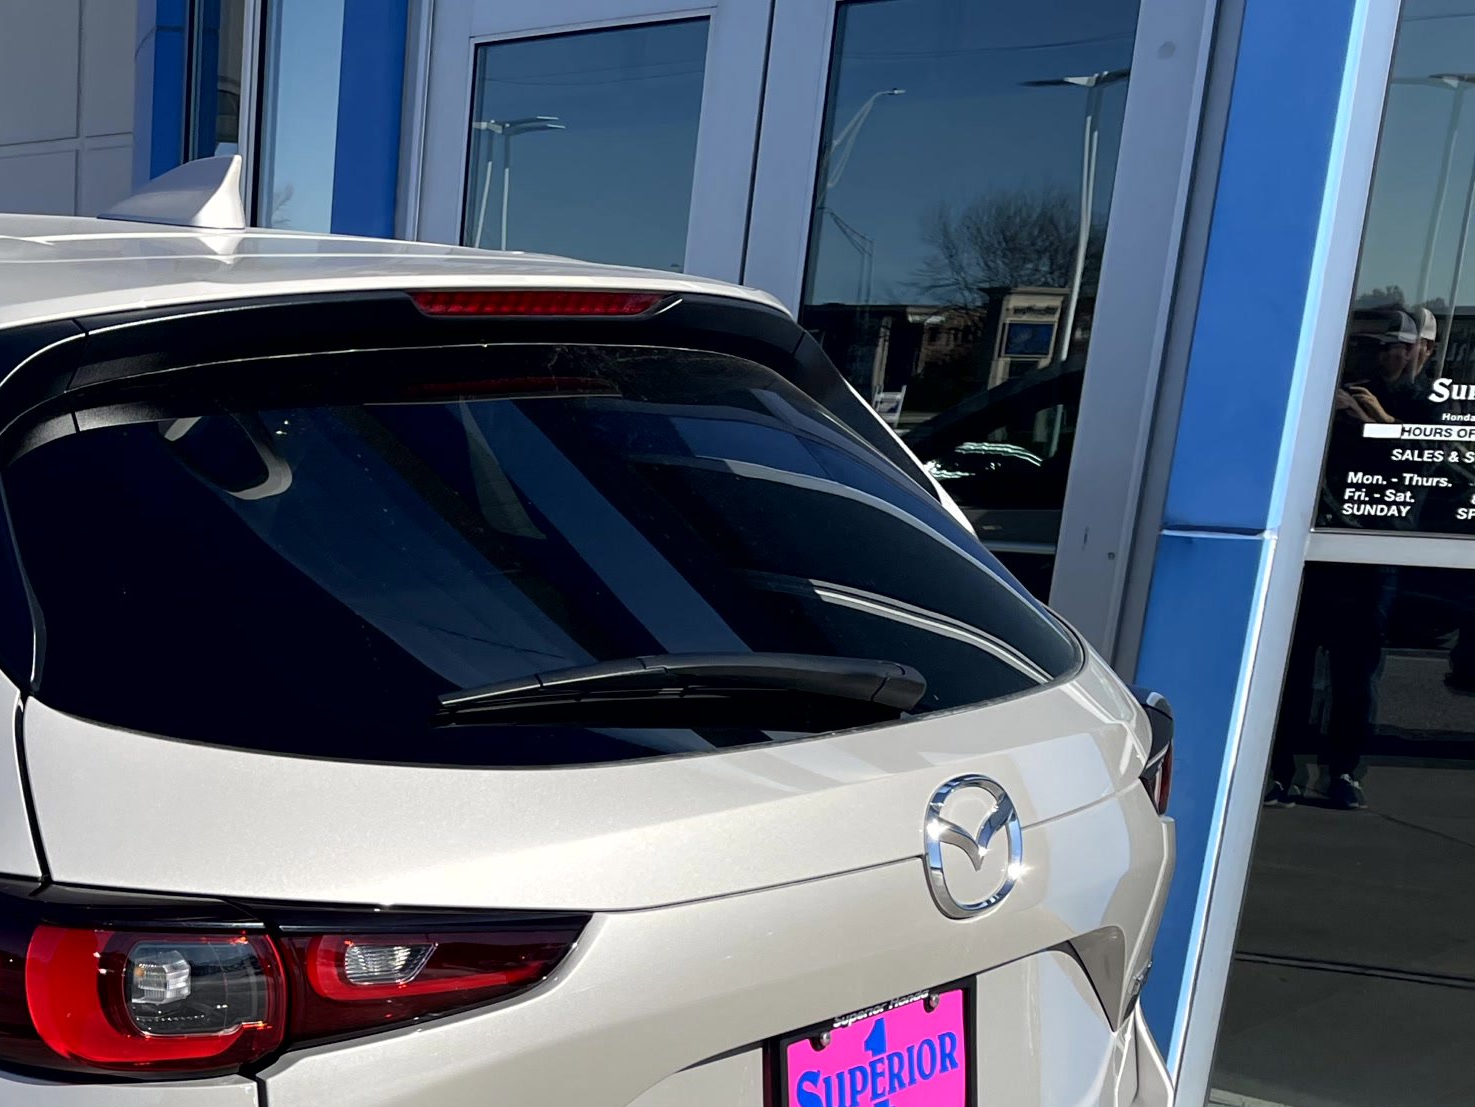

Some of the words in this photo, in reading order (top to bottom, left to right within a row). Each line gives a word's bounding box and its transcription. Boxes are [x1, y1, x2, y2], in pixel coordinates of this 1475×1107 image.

[1402, 426, 1453, 438] HOURS
[1391, 448, 1444, 462] SALES
[1448, 451, 1459, 463] &
[1347, 471, 1387, 485] Mon.
[1402, 473, 1452, 487] Thurs.
[1344, 488, 1369, 501] Fri.
[1384, 489, 1415, 503] Sat.
[1342, 503, 1411, 517] SUNDAY
[832, 1003, 887, 1028] Superior
[888, 989, 930, 1010] Honda
